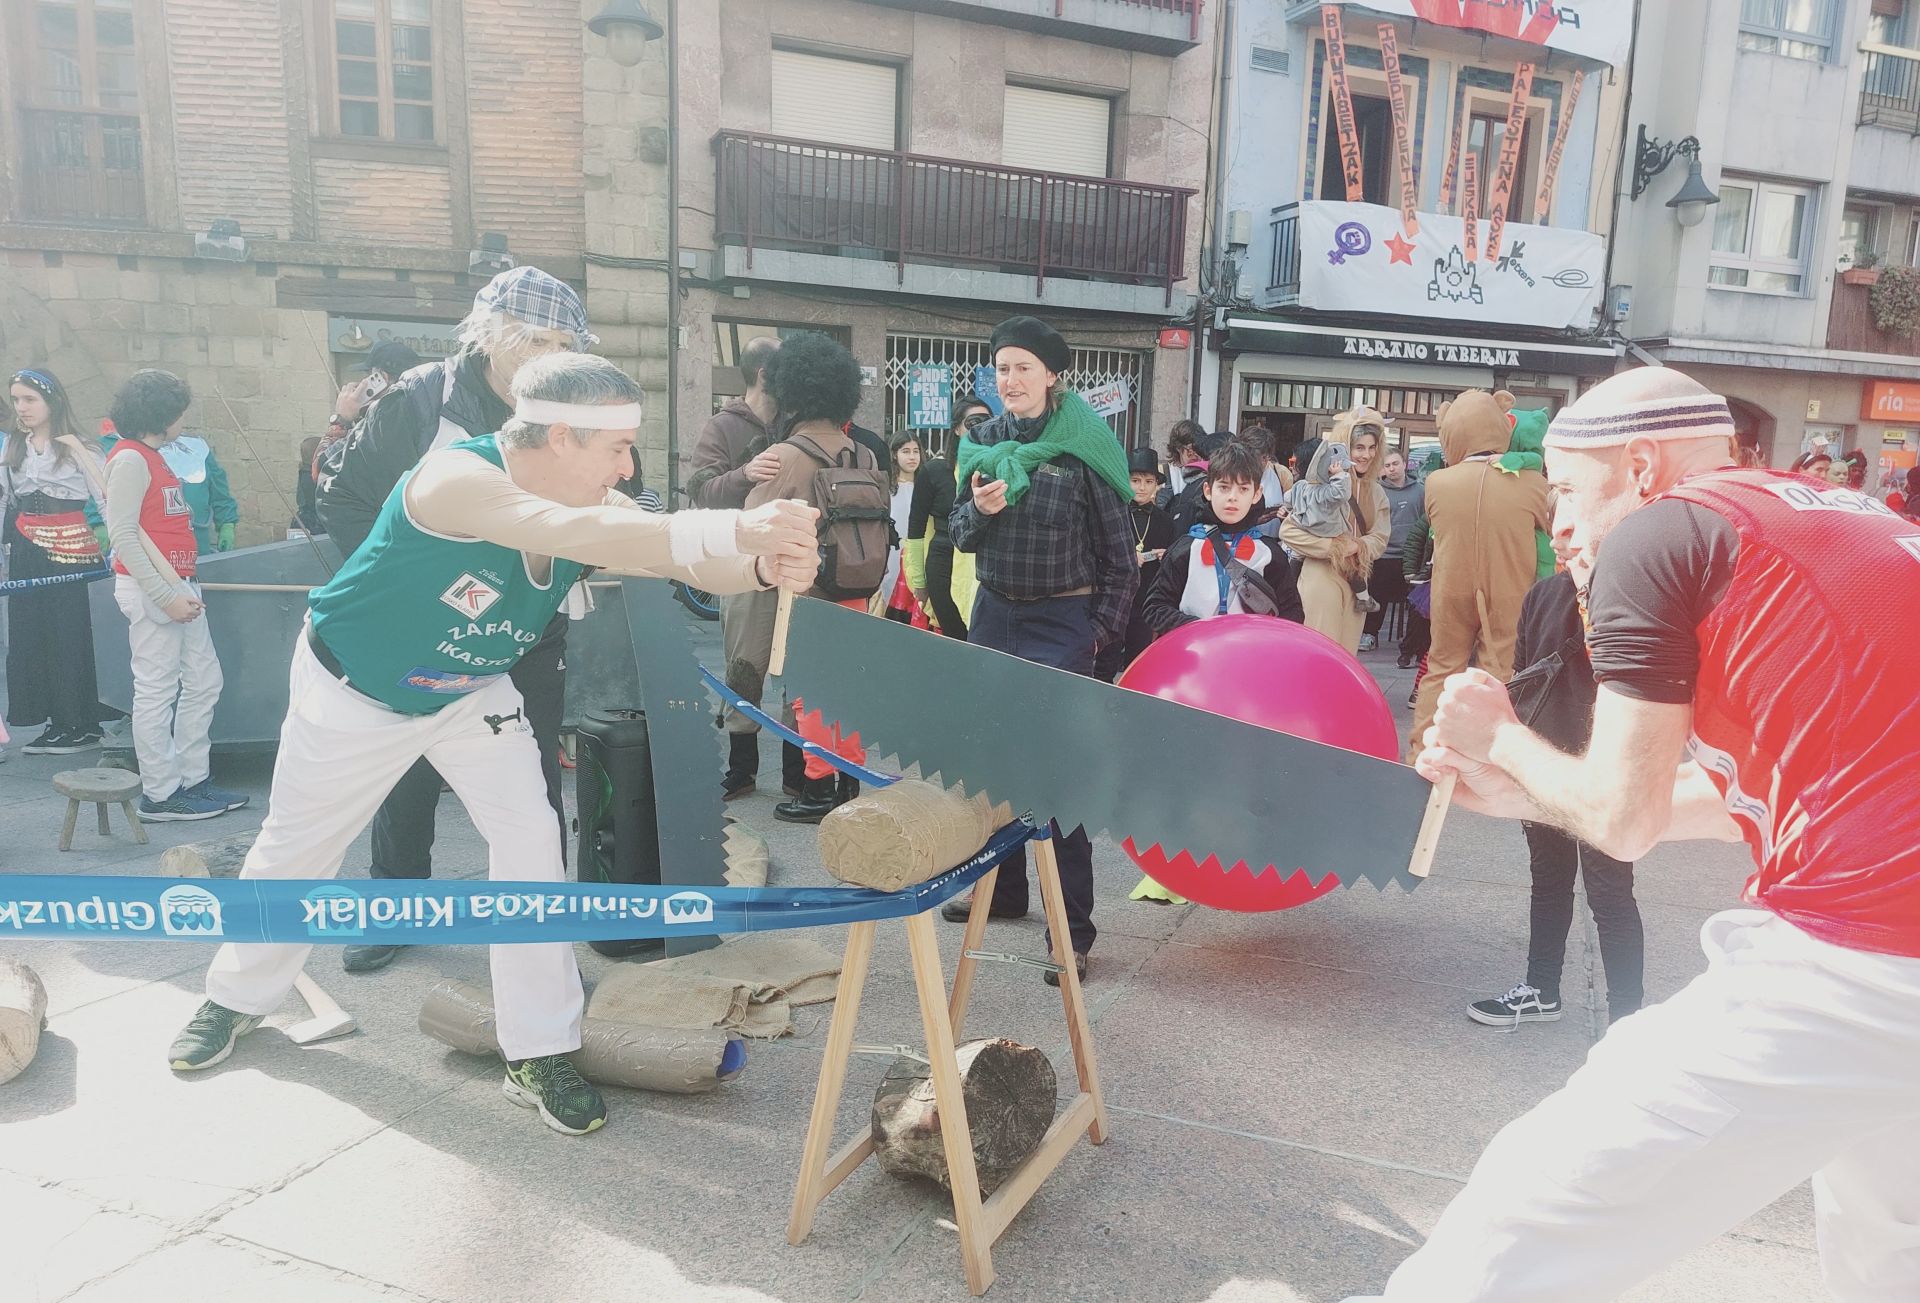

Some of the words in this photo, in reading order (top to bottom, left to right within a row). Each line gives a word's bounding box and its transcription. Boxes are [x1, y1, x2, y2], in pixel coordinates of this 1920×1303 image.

[1326, 13, 1359, 187] BURUJABETZAK
[1379, 25, 1417, 221] INDEPENDENTZIA
[1496, 63, 1530, 194] PALESTINA
[1464, 157, 1477, 249] EUSKARA
[1487, 203, 1504, 258] ASKE
[1509, 258, 1536, 288] etxera
[1343, 337, 1428, 360] ARRANO
[1434, 344, 1521, 366] TABERNA
[912, 382, 940, 397] PEN
[922, 396, 948, 411] DEN
[1877, 387, 1904, 412] ria
[914, 410, 948, 425] TZIA!
[299, 895, 454, 930] Kirolak
